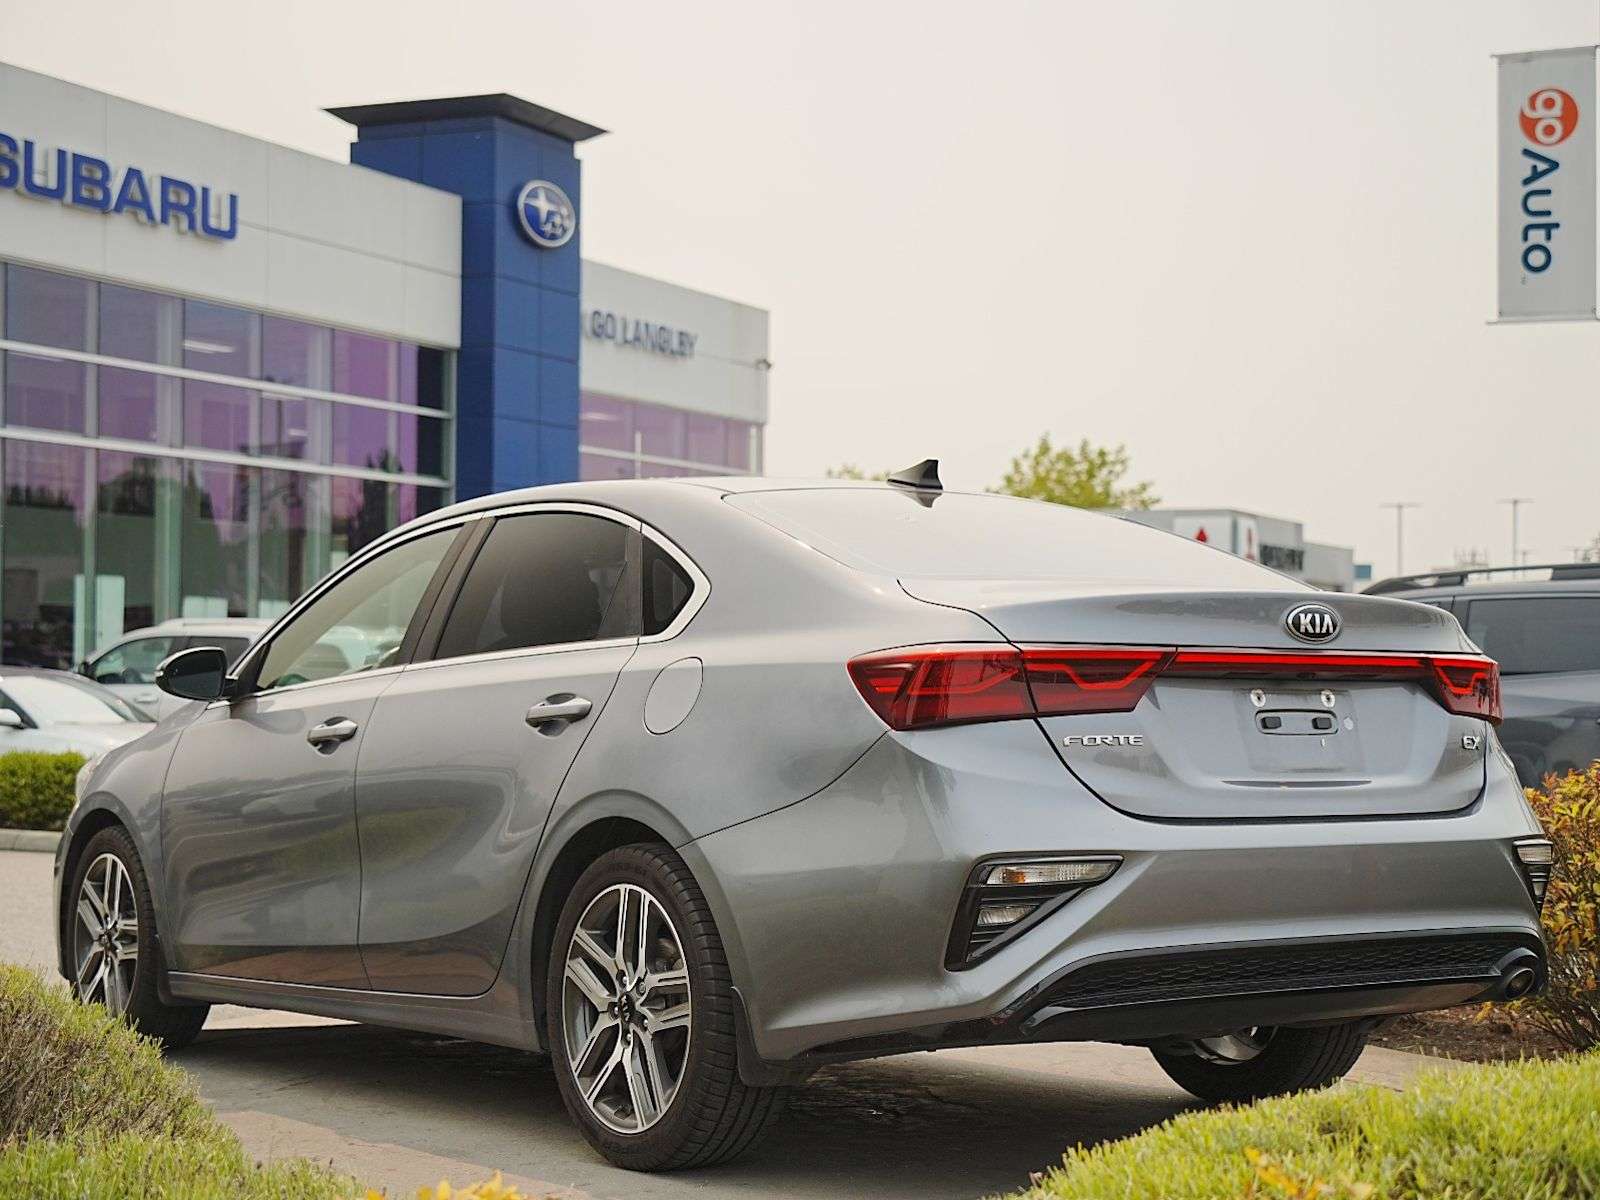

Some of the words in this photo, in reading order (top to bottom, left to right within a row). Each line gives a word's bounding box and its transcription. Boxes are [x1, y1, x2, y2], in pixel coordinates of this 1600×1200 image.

[1299, 613, 1334, 633] KIA
[1063, 734, 1143, 746] FORTE
[1462, 735, 1480, 750] EX
